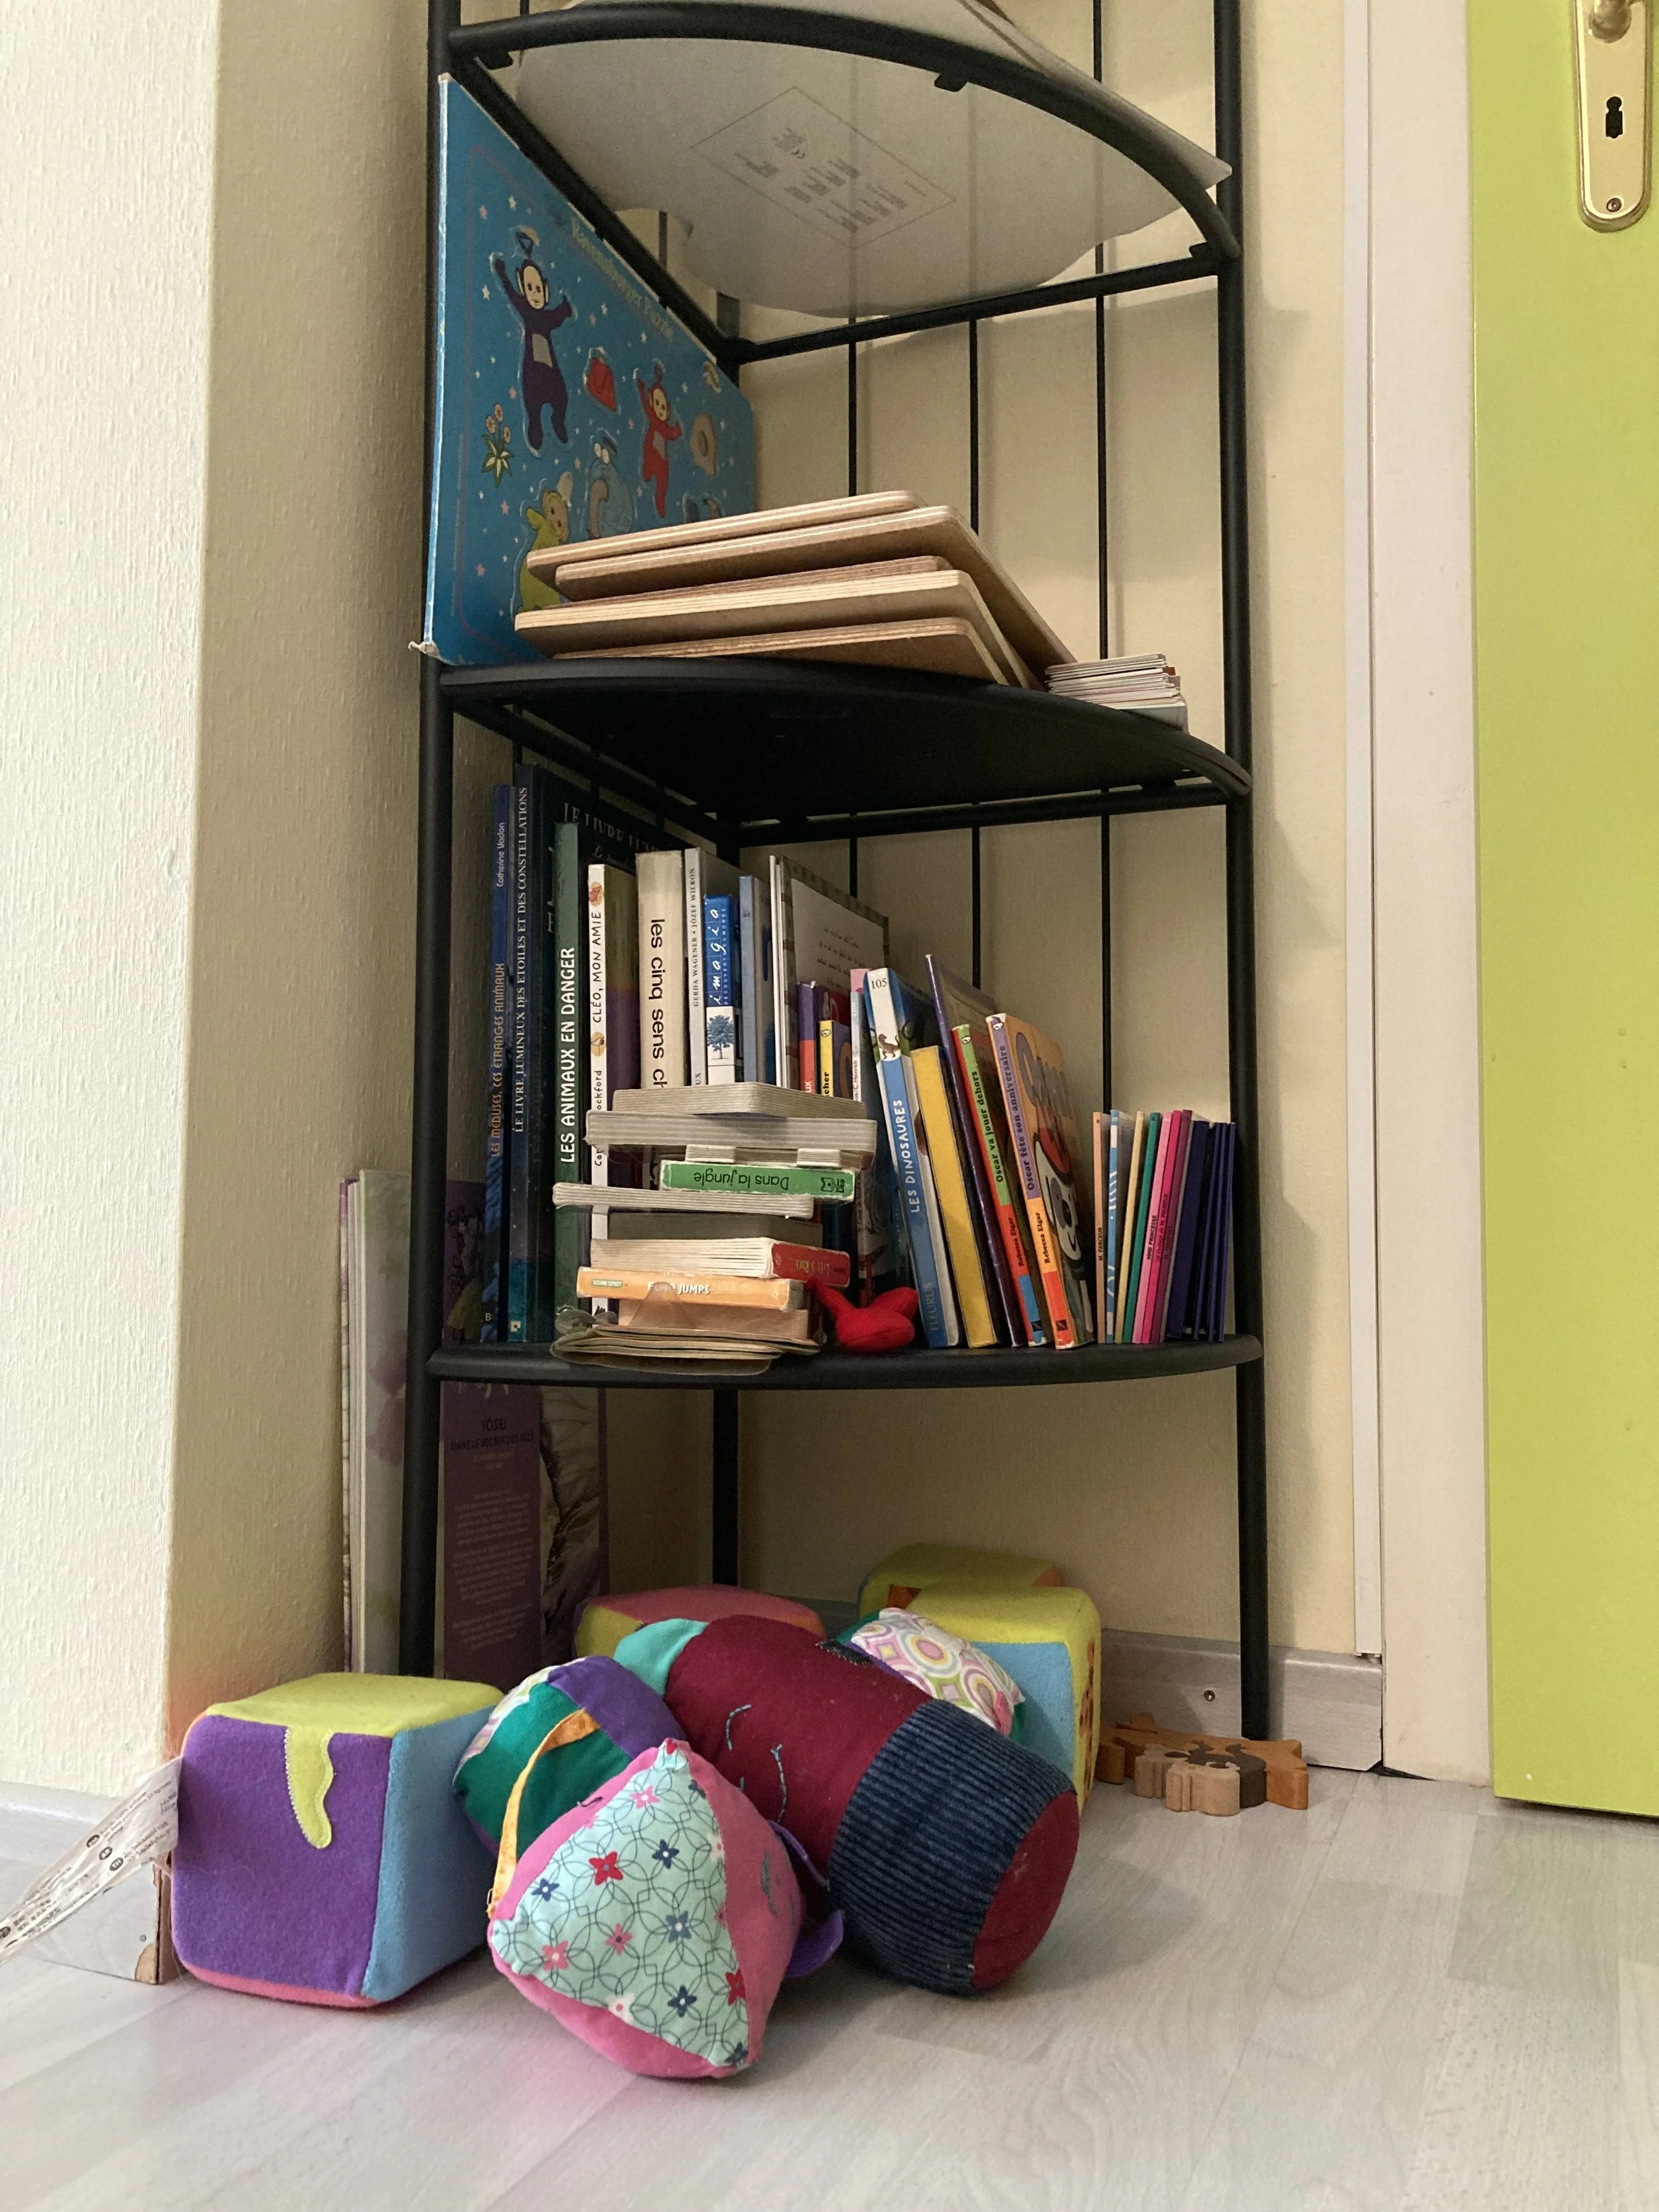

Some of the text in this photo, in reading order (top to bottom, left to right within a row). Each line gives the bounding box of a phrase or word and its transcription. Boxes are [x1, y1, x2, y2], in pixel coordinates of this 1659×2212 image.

[518, 787, 528, 890] CONSTELLATIONS
[496, 849, 504, 887] Catherine
[518, 892, 526, 916] DES
[518, 918, 526, 932] ET
[651, 919, 665, 948] les
[589, 912, 604, 1023] CLÉO, MON AMIE
[648, 957, 666, 999] cinq
[708, 909, 726, 1005] imagia
[516, 988, 525, 1009] DES
[871, 978, 887, 990] 105
[515, 1012, 525, 1078] LUMINEUX
[560, 948, 575, 1163] LES ANIMAUX EN DANGER
[652, 1009, 664, 1059] sens
[514, 1079, 524, 1114] LIVRE
[999, 1045, 1035, 1191] Oscar fête son anniversaire
[514, 1120, 524, 1133] LE
[971, 1070, 1004, 1183] Oscar va jouer dehors
[694, 1168, 789, 1190] Dans la jungle
[893, 1099, 920, 1213] LES DINOSAURES
[1007, 1216, 1025, 1266] Rebecca Elgar
[1035, 1212, 1050, 1264] Rebecca Elgar
[678, 1283, 711, 1295] JUMPS
